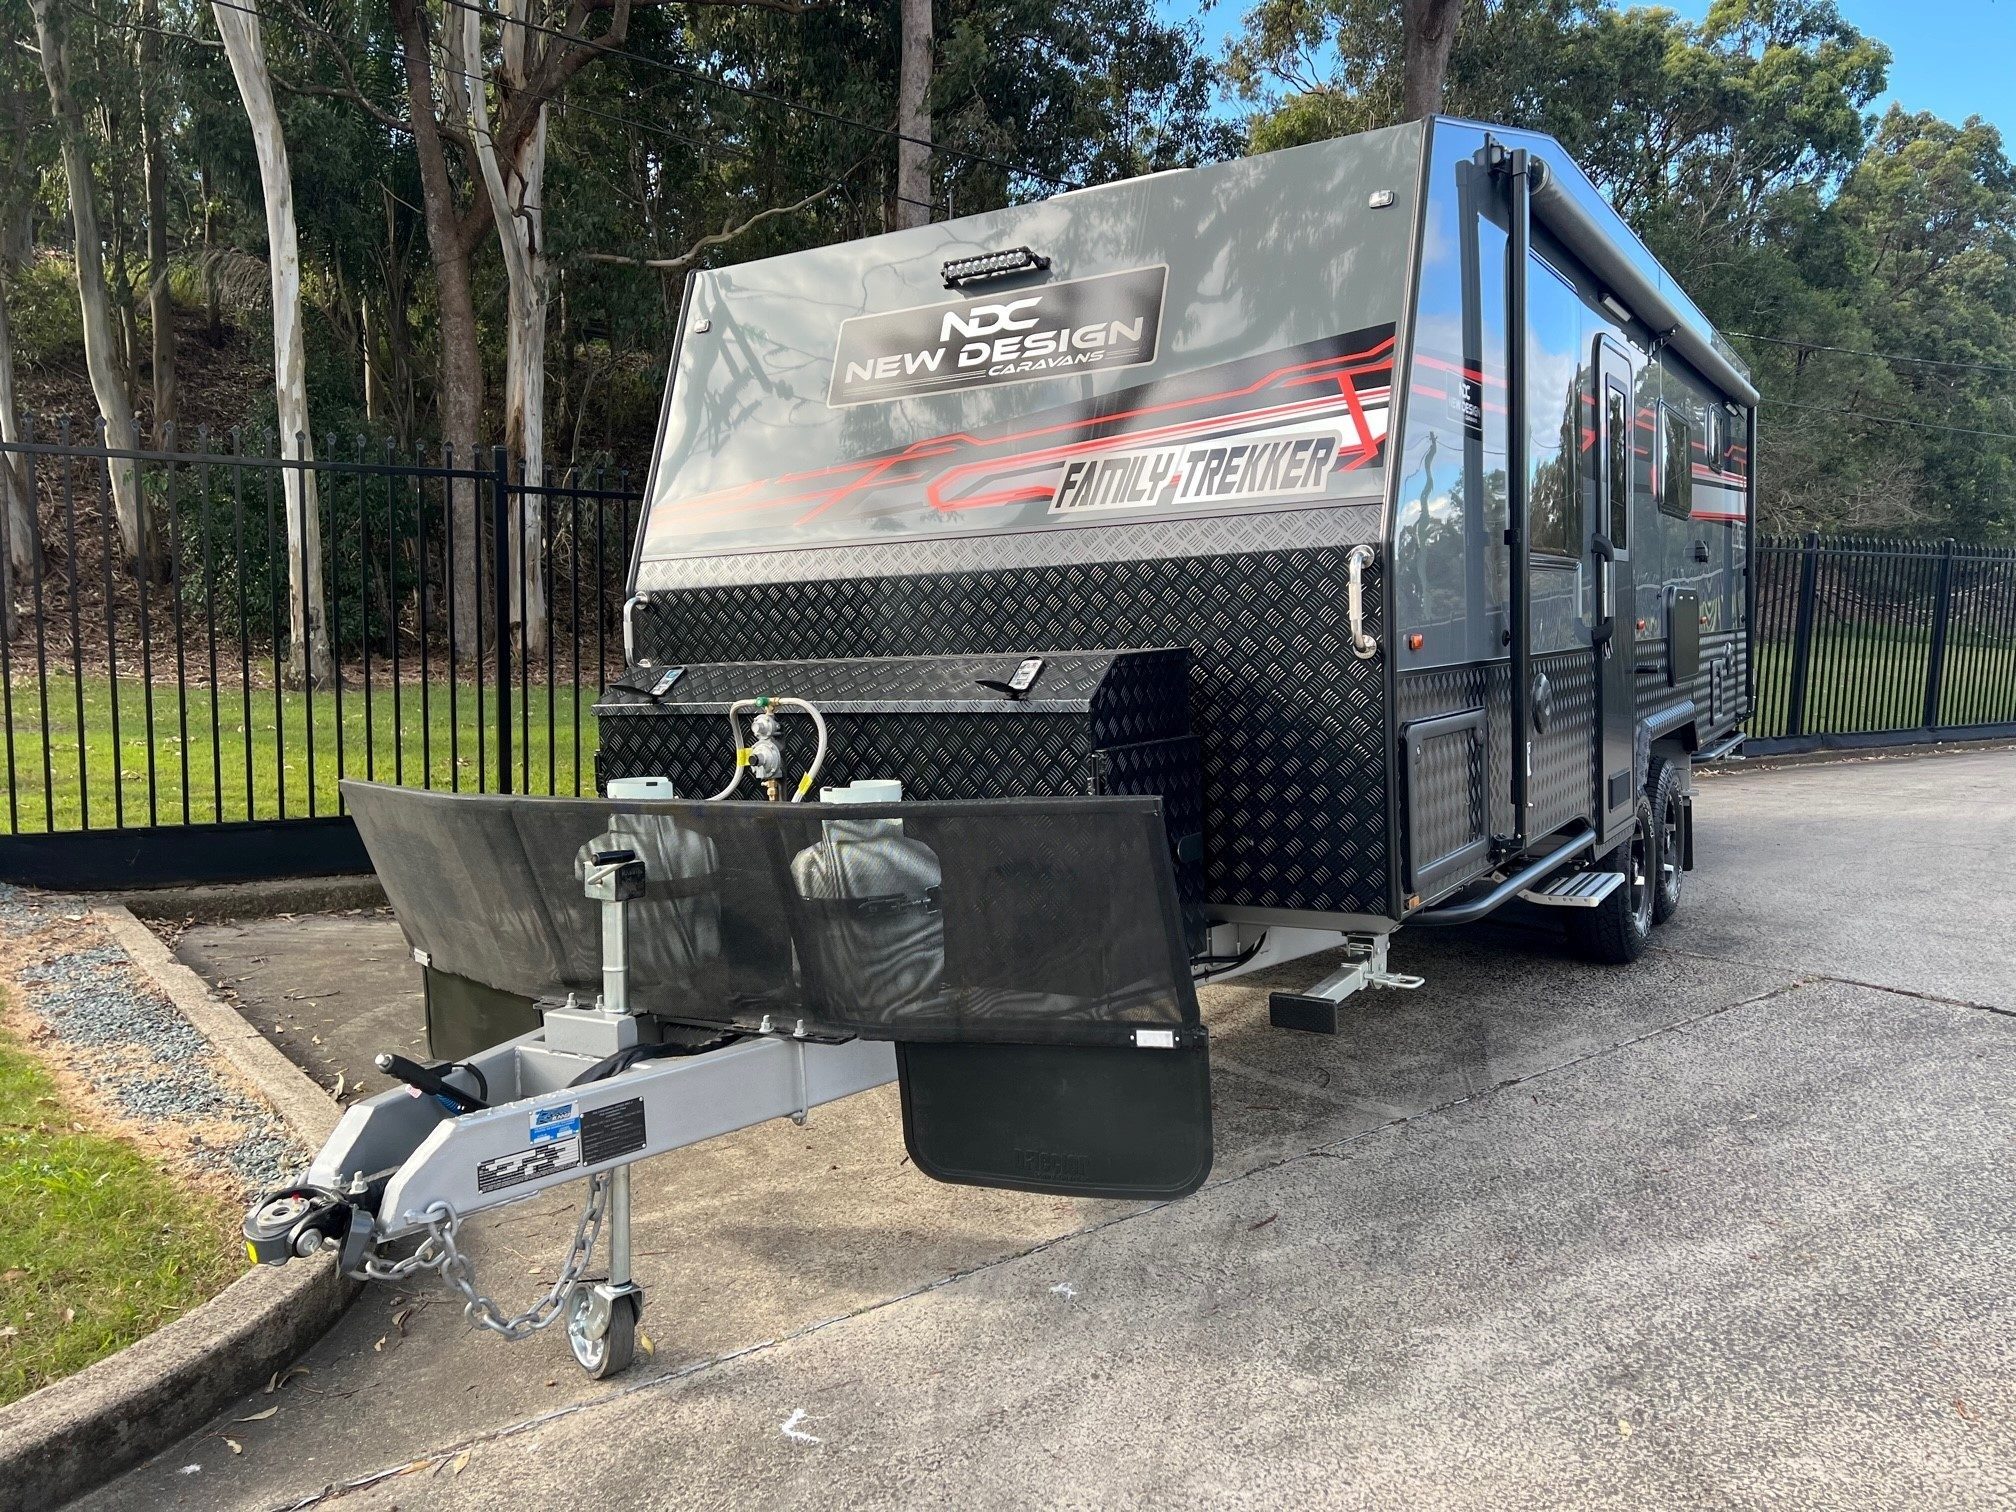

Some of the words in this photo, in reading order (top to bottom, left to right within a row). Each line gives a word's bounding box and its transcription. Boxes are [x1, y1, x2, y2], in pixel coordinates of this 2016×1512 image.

[939, 296, 1042, 342] NDC
[844, 347, 945, 383] NEW
[958, 317, 1144, 368] DESIGN
[988, 350, 1105, 377] CARAVANS
[1055, 452, 1176, 509] FAMILY
[1179, 437, 1337, 498] TREKKER
